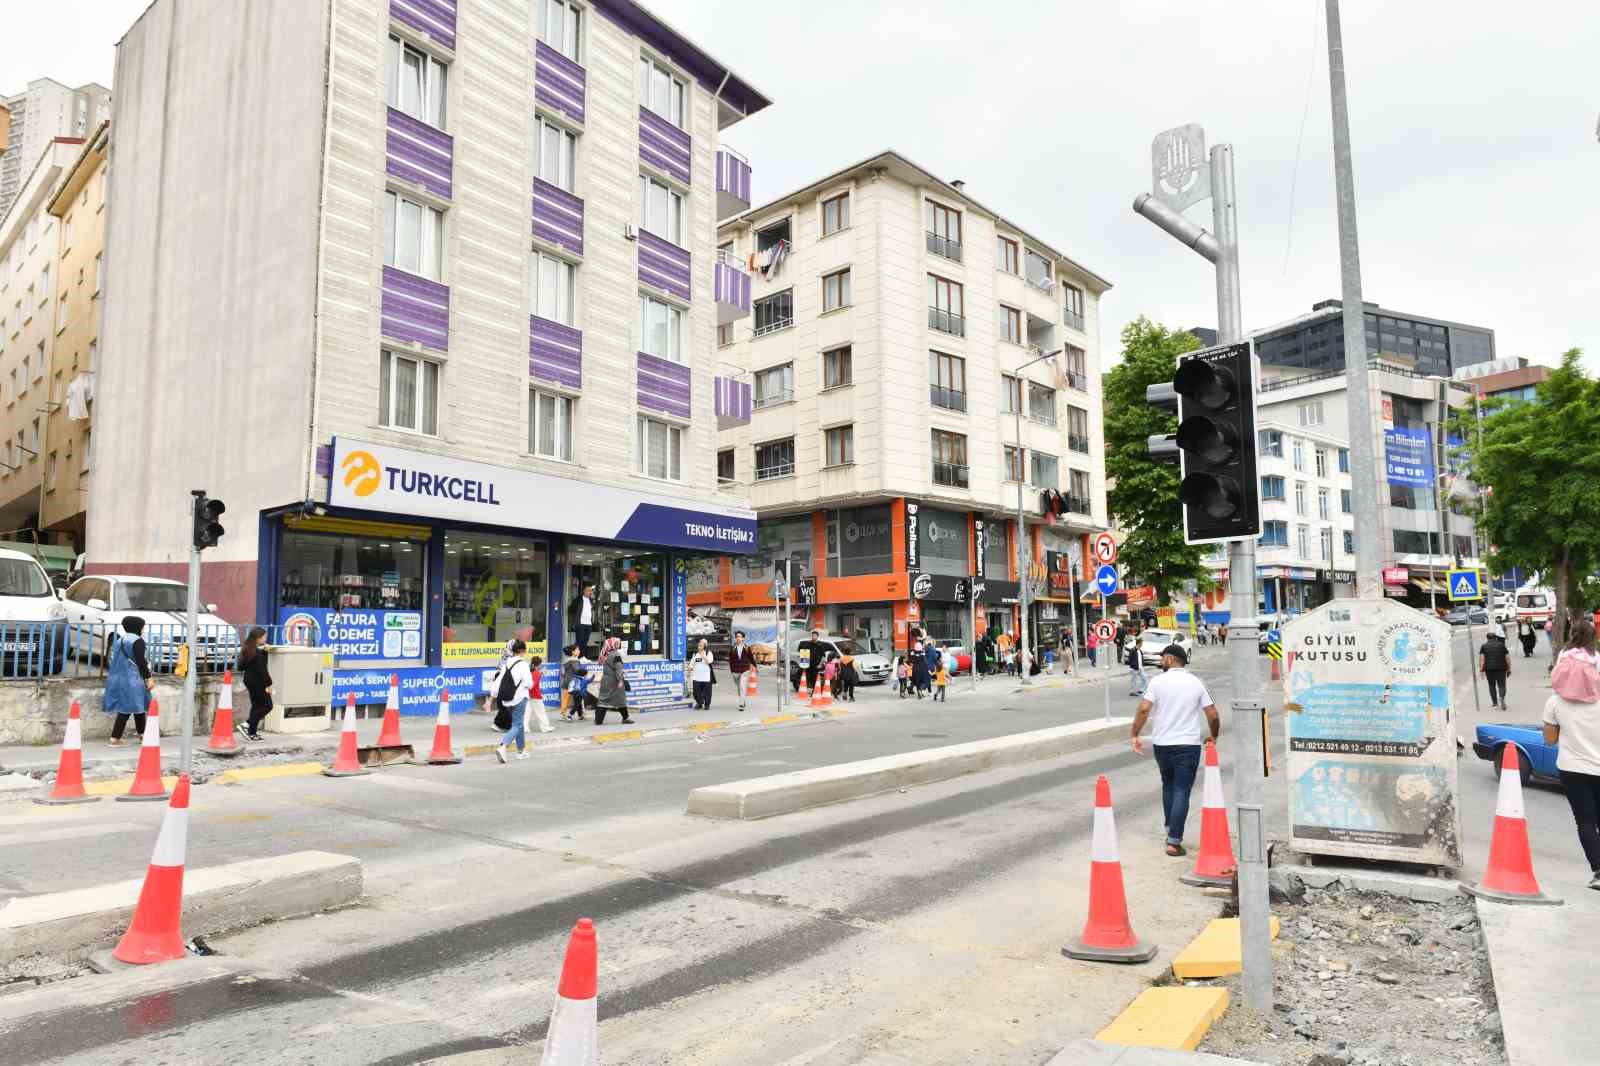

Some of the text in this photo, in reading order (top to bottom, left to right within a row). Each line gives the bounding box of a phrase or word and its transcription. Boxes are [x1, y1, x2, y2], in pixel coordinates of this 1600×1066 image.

[385, 466, 500, 506] TURKCELL
[685, 522, 754, 544] TEKNO İLETİŞİM 2
[326, 613, 377, 625] FATURA
[328, 625, 375, 641] ÖDEME
[1304, 632, 1356, 646] GİYİM
[1295, 651, 1367, 662] KUTUSU
[333, 674, 365, 686] TEKNİK
[402, 689, 473, 707] BAŞVURU OKTASI
